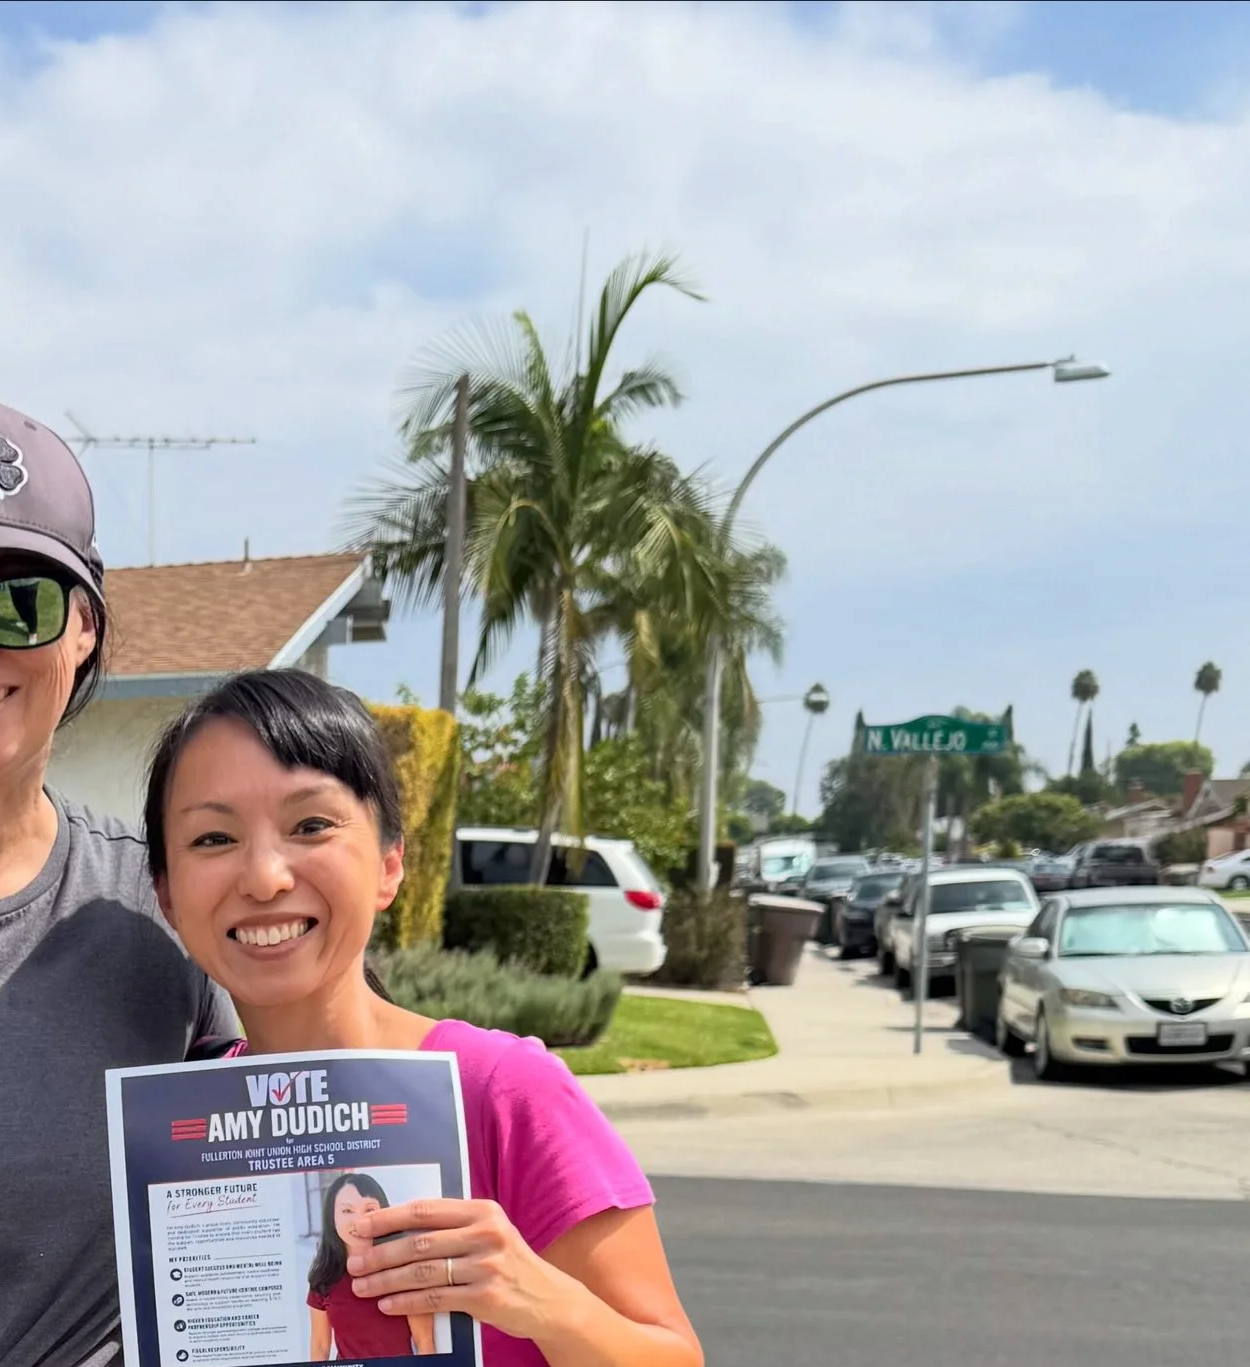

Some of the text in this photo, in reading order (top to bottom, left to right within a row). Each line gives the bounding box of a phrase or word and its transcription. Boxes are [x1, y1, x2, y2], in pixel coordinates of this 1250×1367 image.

[868, 729, 887, 751] N.
[890, 729, 967, 750] VALLEJO
[246, 1070, 329, 1107] VOTE
[208, 1102, 369, 1142] AMY DUDICH
[201, 1139, 381, 1162] FULLERTON JOINT UNION HIGH SCHOOL DISTRICT
[249, 1154, 335, 1171] TRUSTEE AREA 5
[175, 1186, 221, 1197] STRONGER
[225, 1183, 258, 1193] FUTURE
[167, 1193, 257, 1213] for Every Student
